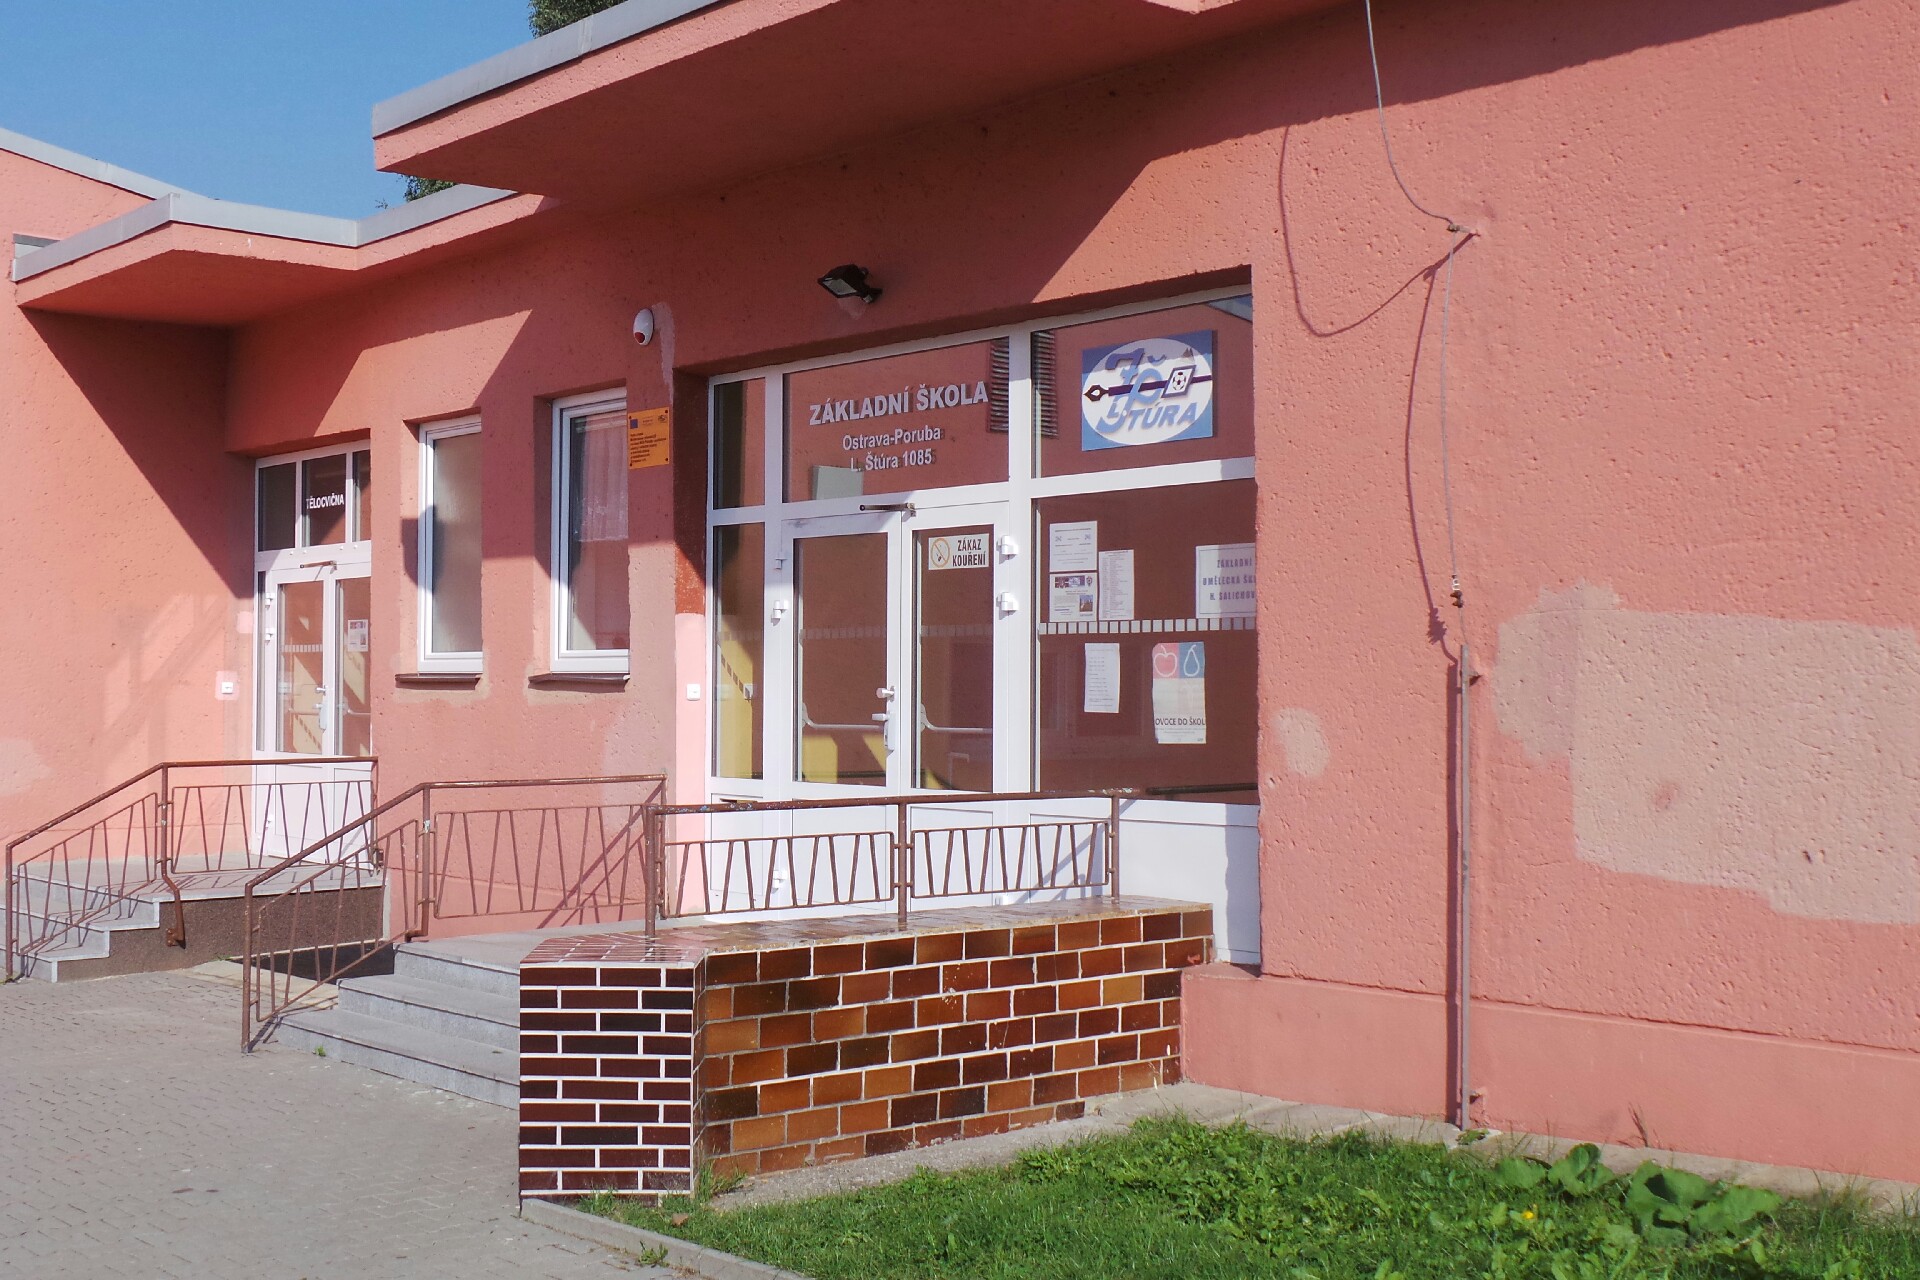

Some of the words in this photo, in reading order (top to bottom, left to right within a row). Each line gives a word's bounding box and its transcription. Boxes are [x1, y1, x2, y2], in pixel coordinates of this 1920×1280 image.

[809, 386, 909, 426] ZÁKLADNÍ
[916, 381, 989, 411] ŠKOLA
[842, 425, 941, 451] Ostrava-Poruba
[850, 457, 861, 472] L.
[865, 451, 898, 471] Štúra
[902, 448, 932, 467] 1085
[306, 492, 345, 510] TĚLOCVIČNA
[957, 536, 982, 551] ZÁKAZ
[952, 551, 986, 567] KOUŘENÍ
[1155, 717, 1176, 726] OVOCE
[1178, 717, 1188, 726] DO
[1189, 715, 1205, 726] ŠKOL
